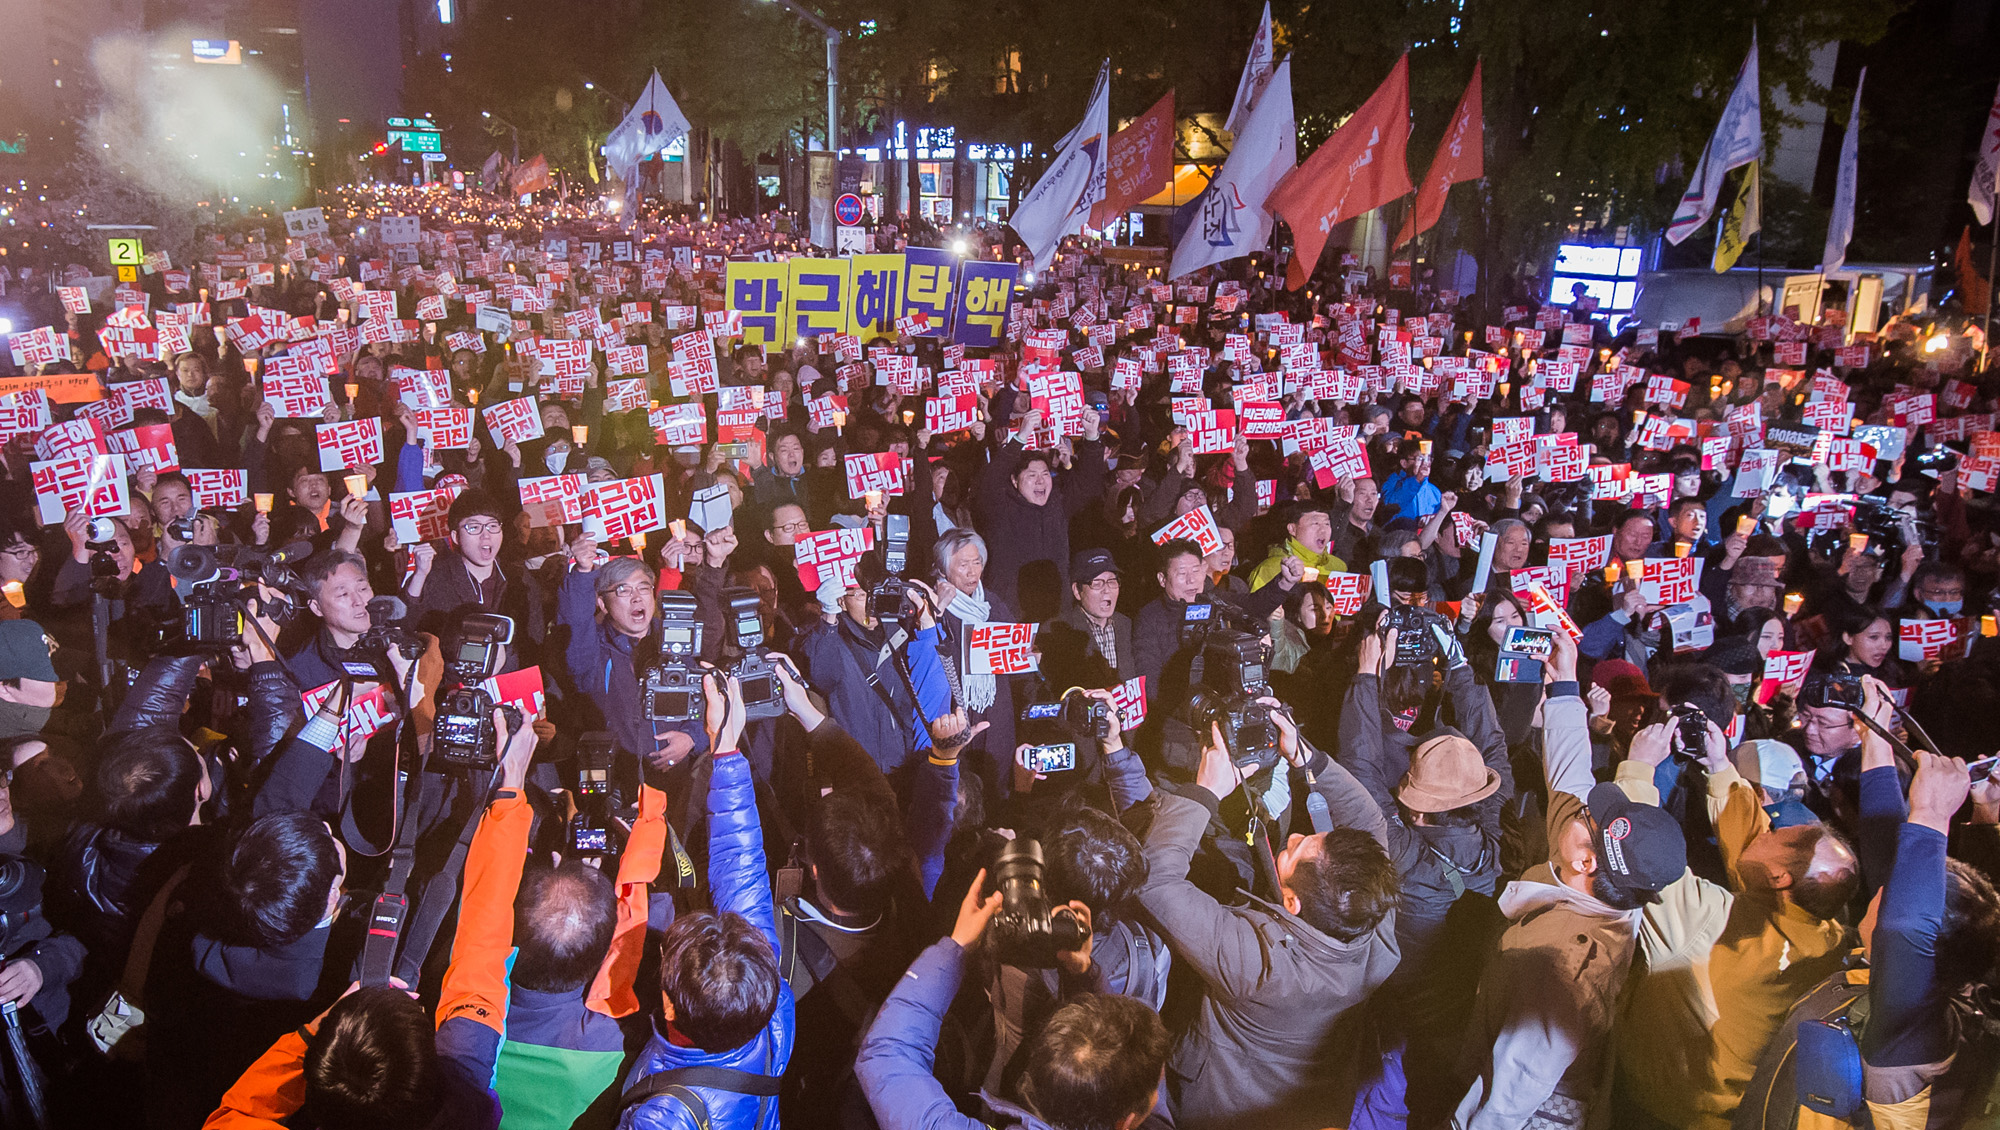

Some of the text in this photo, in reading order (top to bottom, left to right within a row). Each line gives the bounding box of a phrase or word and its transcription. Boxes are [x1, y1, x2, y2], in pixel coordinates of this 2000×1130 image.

[118, 243, 130, 259] 2
[124, 268, 130, 276] 2
[356, 291, 393, 307] 박근혜
[734, 264, 1010, 342] 박근혜 탄핵
[566, 308, 596, 326] 박근혜
[622, 303, 637, 314] 이게
[704, 312, 724, 324] 이게
[896, 317, 914, 330] 이게
[9, 329, 50, 348] 박근혜
[107, 328, 134, 342] 이게
[594, 323, 614, 338] 이게
[1089, 325, 1114, 338] 박근혜
[1271, 324, 1301, 336] 박근혜
[1379, 330, 1396, 341] 이게
[672, 331, 708, 352] 박근혜
[834, 337, 860, 352] 박근혜
[1097, 334, 1114, 345] 퇴진
[1415, 339, 1442, 351] 박근혜
[23, 345, 53, 363] 퇴진
[540, 341, 587, 359] 박근혜
[606, 346, 644, 365] 박근혜
[1073, 346, 1100, 362] 박근혜
[265, 356, 315, 377] 박근혜
[555, 359, 587, 378] 퇴진
[621, 359, 645, 374] 퇴진
[668, 359, 713, 381] 박근혜
[877, 356, 913, 373] 박근혜
[960, 360, 980, 374] 이게
[1084, 354, 1102, 368] 퇴진
[1291, 355, 1314, 368] 퇴진
[1536, 360, 1574, 377] 박근혜
[888, 370, 912, 384] 퇴진
[938, 371, 976, 390] 박근혜
[1174, 369, 1202, 383] 박근혜
[1303, 371, 1340, 388] 박근혜
[1386, 366, 1420, 380] 박근혜
[1456, 370, 1492, 384] 박근혜
[1593, 374, 1624, 390] 박근혜
[264, 375, 323, 397] 박근혜
[685, 376, 715, 395] 퇴진
[1030, 373, 1080, 398] 박근혜
[1181, 381, 1201, 393] 퇴진
[1233, 384, 1265, 398] 박근혜
[1546, 377, 1571, 392] 퇴진
[1648, 376, 1671, 390] 이게
[1313, 385, 1339, 400] 퇴진
[285, 396, 324, 417] 퇴진
[621, 394, 648, 410] 퇴진
[809, 398, 831, 413] 이게
[926, 397, 956, 417] 이게
[1049, 394, 1083, 418] 퇴진
[1803, 403, 1847, 418] 박근혜
[1894, 394, 1933, 414] 박근혜
[0, 406, 38, 428] 근혜
[416, 409, 470, 429] 박근혜
[484, 397, 531, 430] 박근혜
[718, 412, 739, 426] 이게
[1186, 413, 1216, 431] 이게
[1243, 408, 1282, 421] 박근혜는
[317, 419, 376, 448] 박근혜
[665, 423, 703, 444] 퇴진
[1282, 418, 1328, 440] 박근혜
[1815, 417, 1845, 432] 퇴진
[34, 419, 95, 460] 박근혜
[106, 430, 140, 452] 이게
[433, 428, 470, 448] 퇴진
[1299, 435, 1329, 450] 퇴진
[1767, 427, 1815, 447] 하야하라
[341, 440, 380, 468] 퇴진
[1310, 440, 1362, 472] 박근혜
[1490, 440, 1537, 465] 박근혜
[1831, 440, 1860, 454] 이게
[846, 456, 878, 478] 이게
[1507, 460, 1537, 477] 퇴진
[1550, 464, 1583, 482] 퇴진
[1589, 468, 1612, 481] 이게
[187, 470, 242, 491] 박근혜
[522, 474, 580, 503] 박근혜
[390, 488, 454, 520] 박근혜
[581, 475, 657, 519] 박근혜
[604, 503, 658, 541] 퇴진
[796, 528, 867, 564] 박근혜
[1549, 537, 1606, 561] 박근혜
[1643, 558, 1696, 582] 박근혜
[1326, 574, 1370, 596] 박근혜
[1659, 582, 1694, 605] 퇴진
[971, 624, 1032, 650] 박근혜
[988, 648, 1031, 674] 퇴진
[376, 915, 398, 924] Canon
